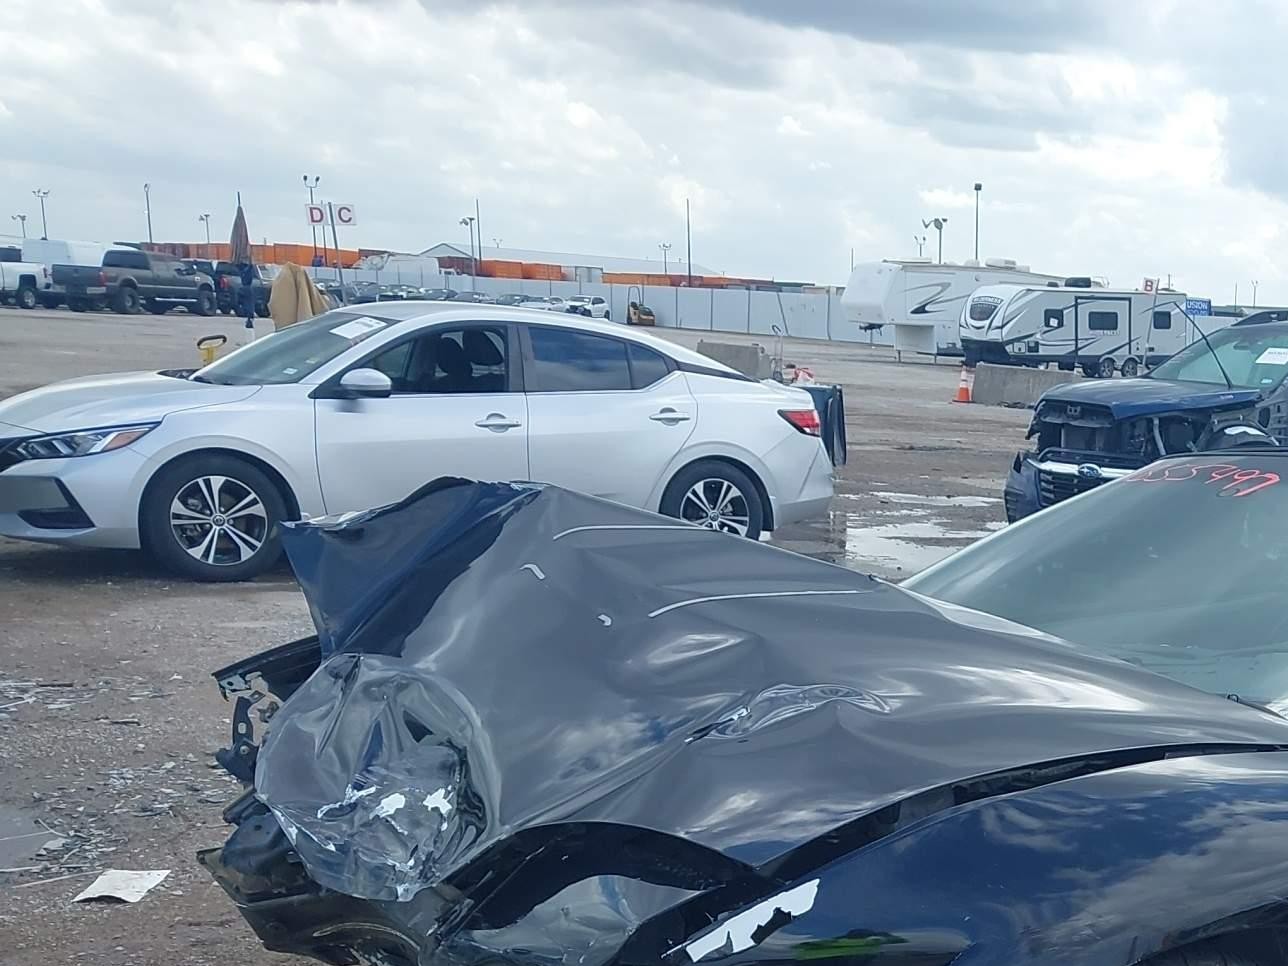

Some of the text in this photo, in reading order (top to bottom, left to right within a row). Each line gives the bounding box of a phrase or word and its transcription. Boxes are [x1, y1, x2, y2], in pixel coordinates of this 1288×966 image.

[309, 206, 324, 223] D
[337, 206, 353, 223] C
[1144, 279, 1154, 292] B
